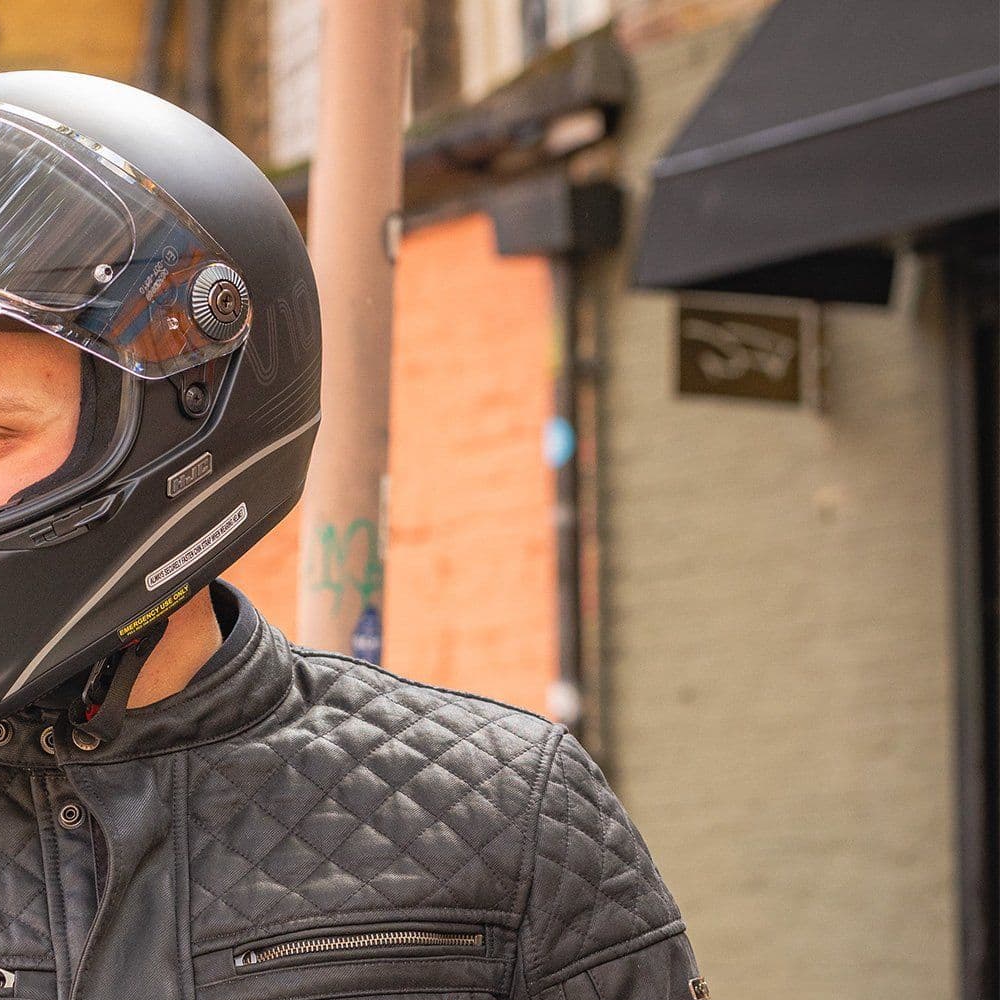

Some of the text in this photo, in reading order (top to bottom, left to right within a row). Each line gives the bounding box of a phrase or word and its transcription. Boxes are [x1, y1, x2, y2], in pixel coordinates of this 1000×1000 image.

[119, 606, 160, 636] EMERGENCY
[160, 597, 173, 610] USE
[173, 583, 189, 600] ONLY
